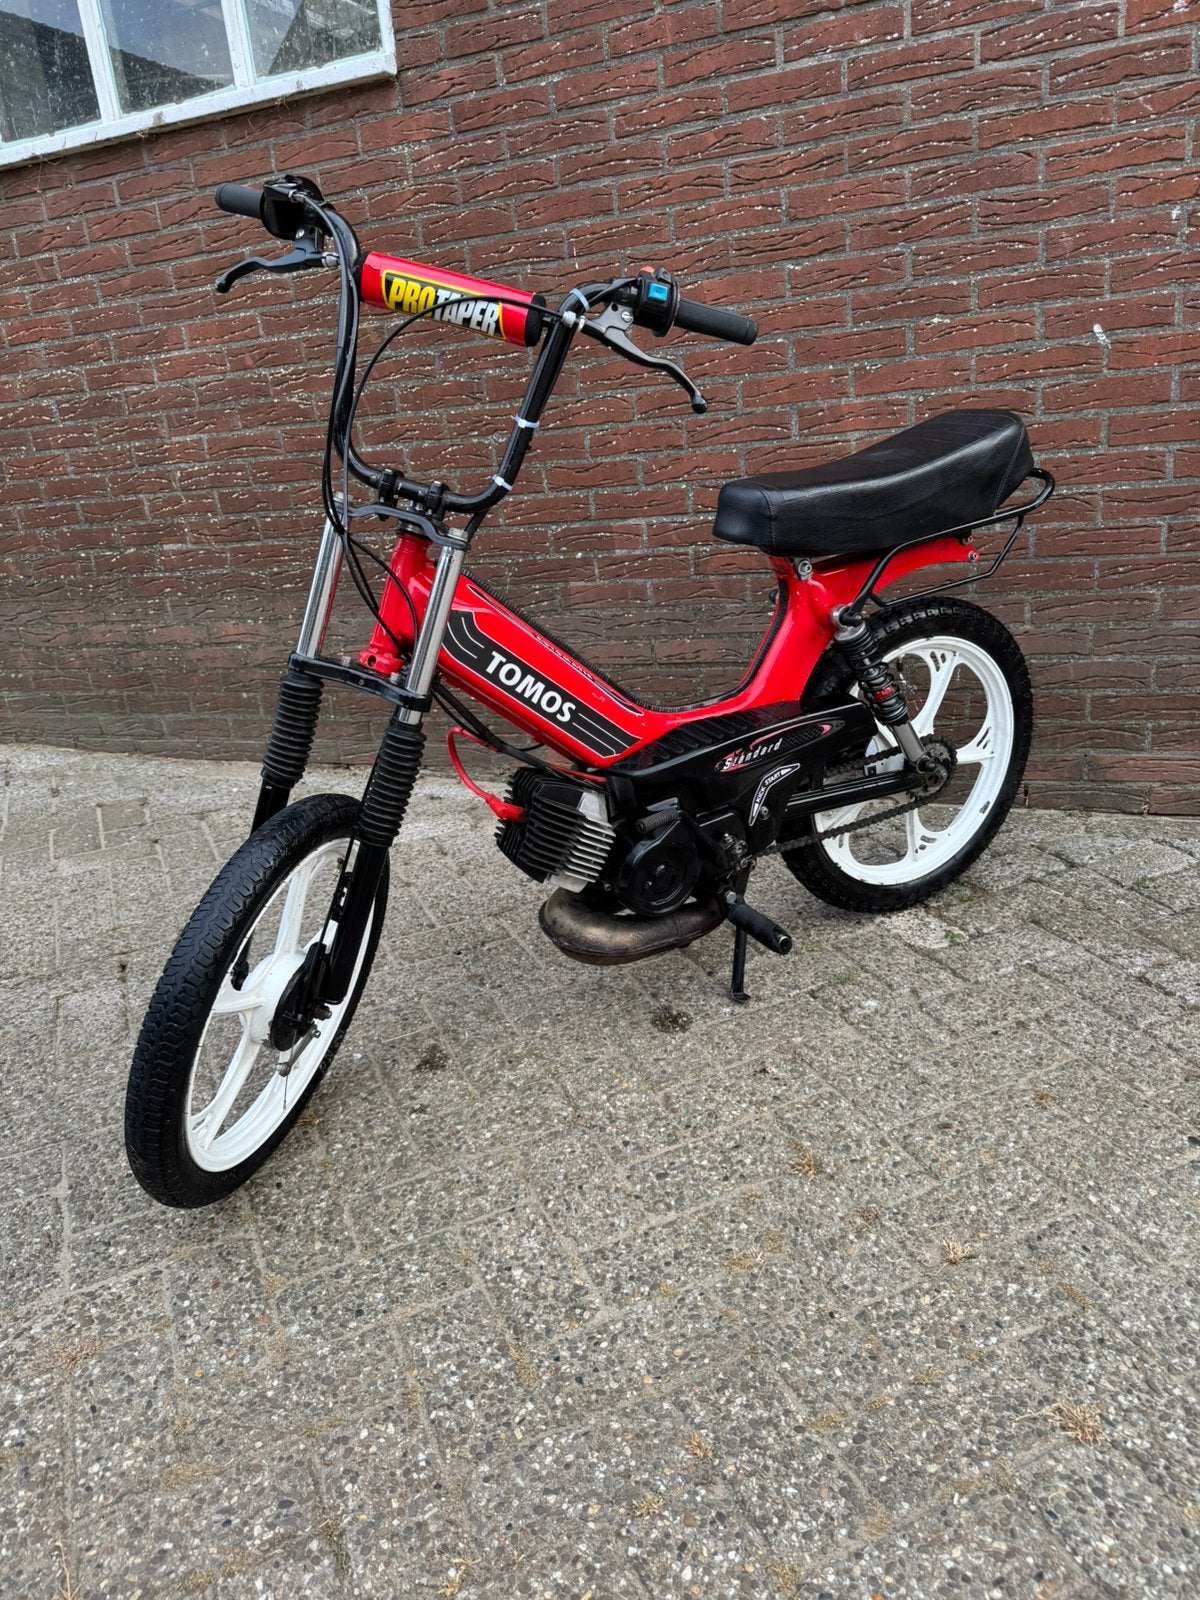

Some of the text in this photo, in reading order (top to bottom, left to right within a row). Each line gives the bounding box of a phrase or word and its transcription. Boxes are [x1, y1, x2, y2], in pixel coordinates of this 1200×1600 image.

[485, 651, 576, 722] TOMOS
[723, 738, 783, 770] Standard
[756, 771, 781, 803] KICK START
